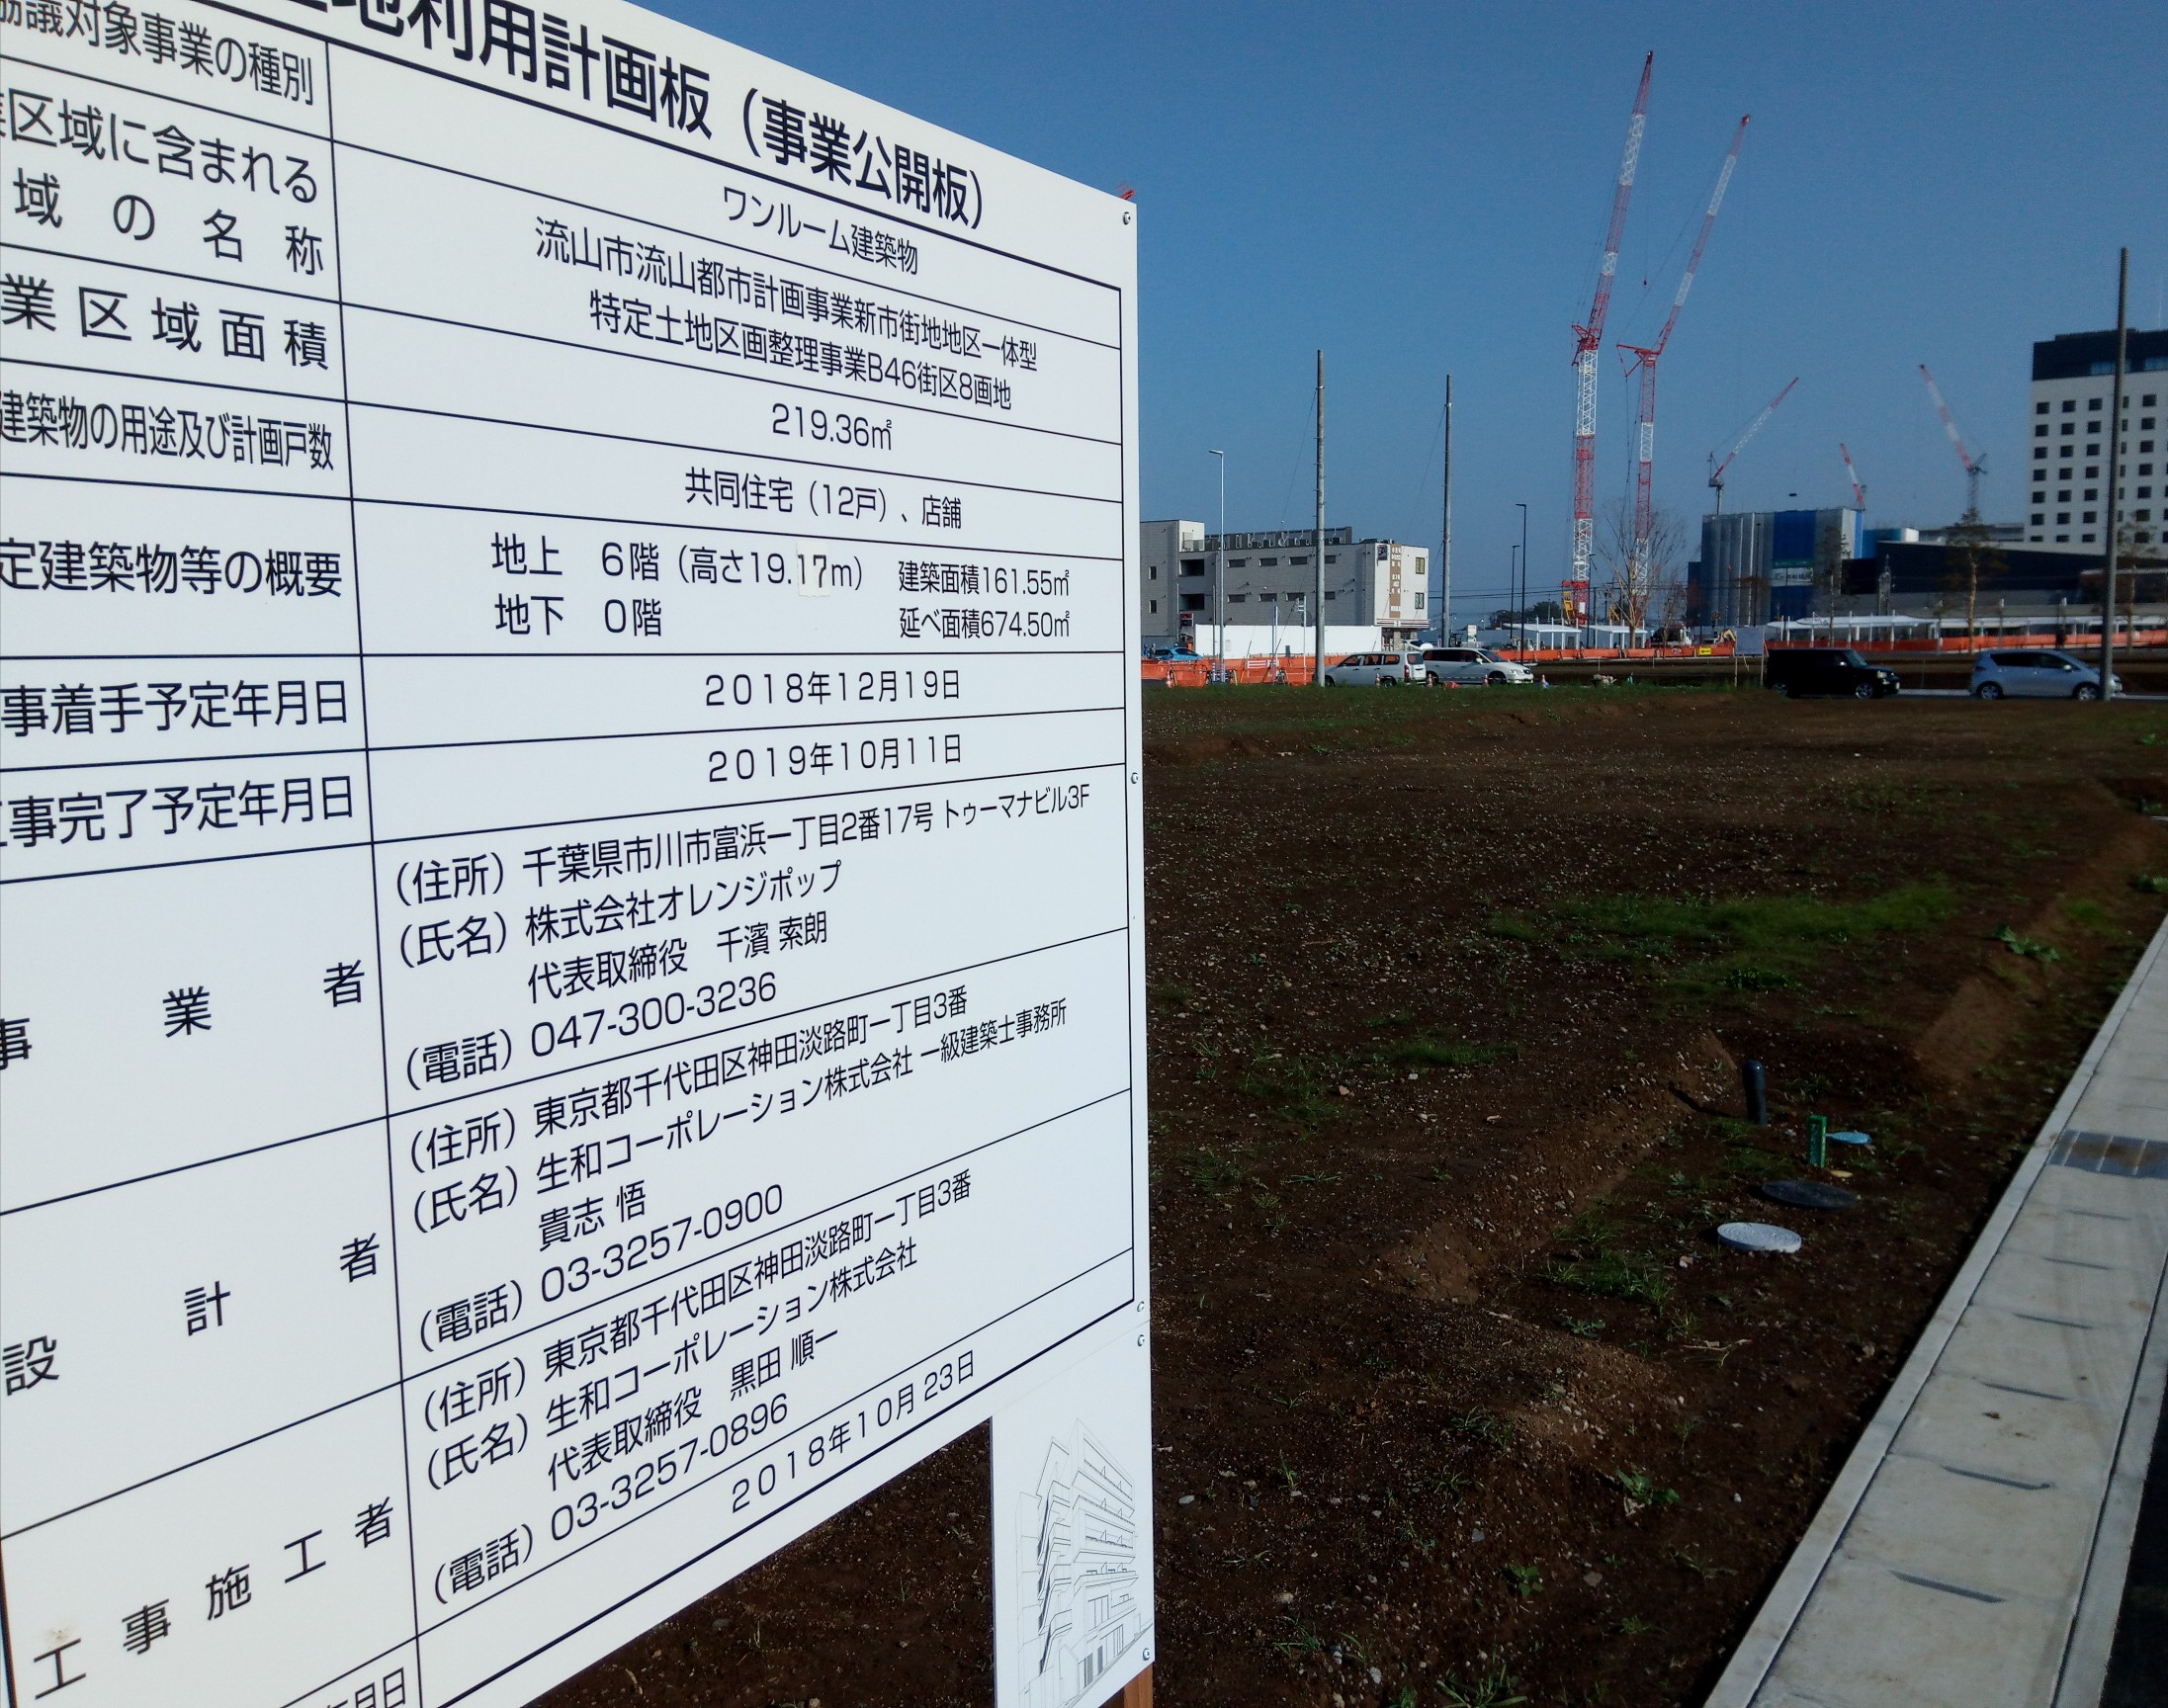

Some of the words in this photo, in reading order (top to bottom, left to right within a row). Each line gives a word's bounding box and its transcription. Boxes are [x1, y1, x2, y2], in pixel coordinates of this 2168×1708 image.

[0, 0, 313, 106] 議対象事業の種別
[0, 87, 317, 204] 区域に含まれる
[724, 186, 918, 276] ワンルーム建築物
[535, 215, 1038, 372] 流山市流山都市計画事業新市街地地区一体型
[589, 289, 1012, 411] 特定土地区画整理事業B46街区8画地
[490, 532, 564, 576] 地上
[898, 559, 1070, 597] 建築面積161.55㎡
[493, 593, 564, 637] 地下
[899, 607, 1071, 640] 延べ面積674.50㎡
[705, 669, 960, 707] 2018年12月19日
[708, 733, 961, 783] 2019年10月11日
[0, 775, 353, 848] 事完了予定年月日
[524, 859, 842, 947] 株式会社オレンジポップ
[527, 937, 688, 1004] 代表取締役
[531, 971, 776, 1058] 047-300-3236
[536, 1044, 913, 1195] 生和コーポレーション株式会社
[538, 1196, 605, 1252] 貴志
[615, 1179, 647, 1224] 悟
[541, 1183, 783, 1303] 03-3257-0900
[546, 1236, 917, 1438] 生和コーポレーション株式会社
[548, 1385, 703, 1492] 代表取締役
[730, 1345, 781, 1402] 黒田
[551, 1393, 788, 1541] 03-3257-0896
